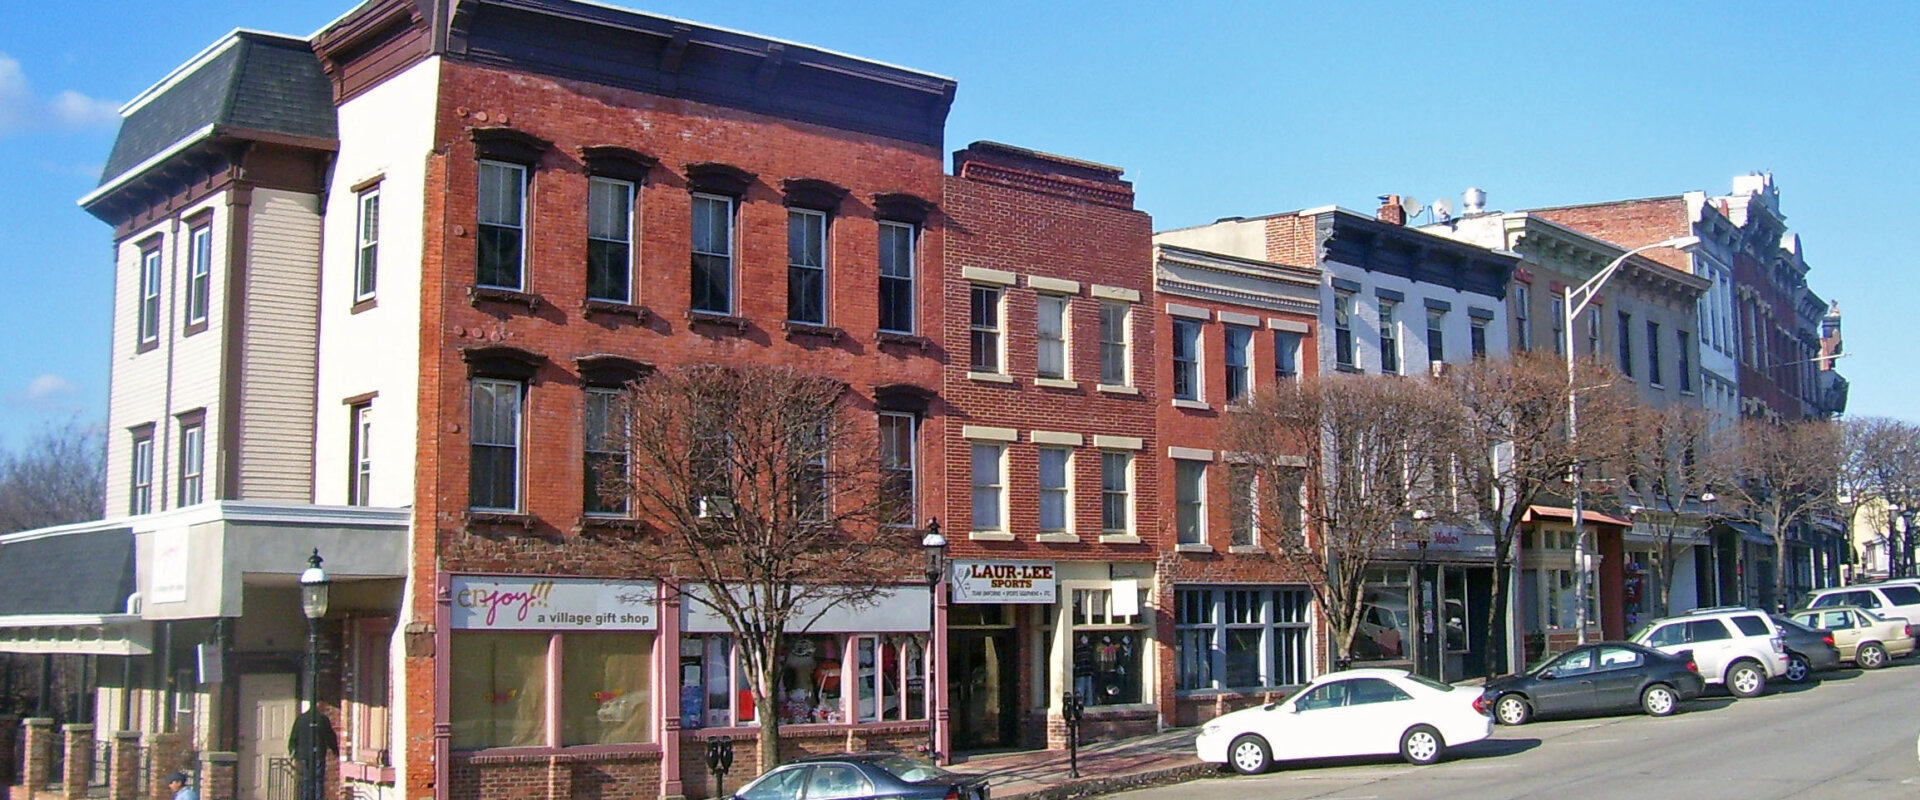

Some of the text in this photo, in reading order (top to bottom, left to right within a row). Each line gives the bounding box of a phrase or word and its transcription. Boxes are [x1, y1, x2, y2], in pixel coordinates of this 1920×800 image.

[971, 564, 1053, 579] LAUR-LEE
[991, 580, 1032, 589] SPORTS
[537, 611, 650, 626] a village gift shop
